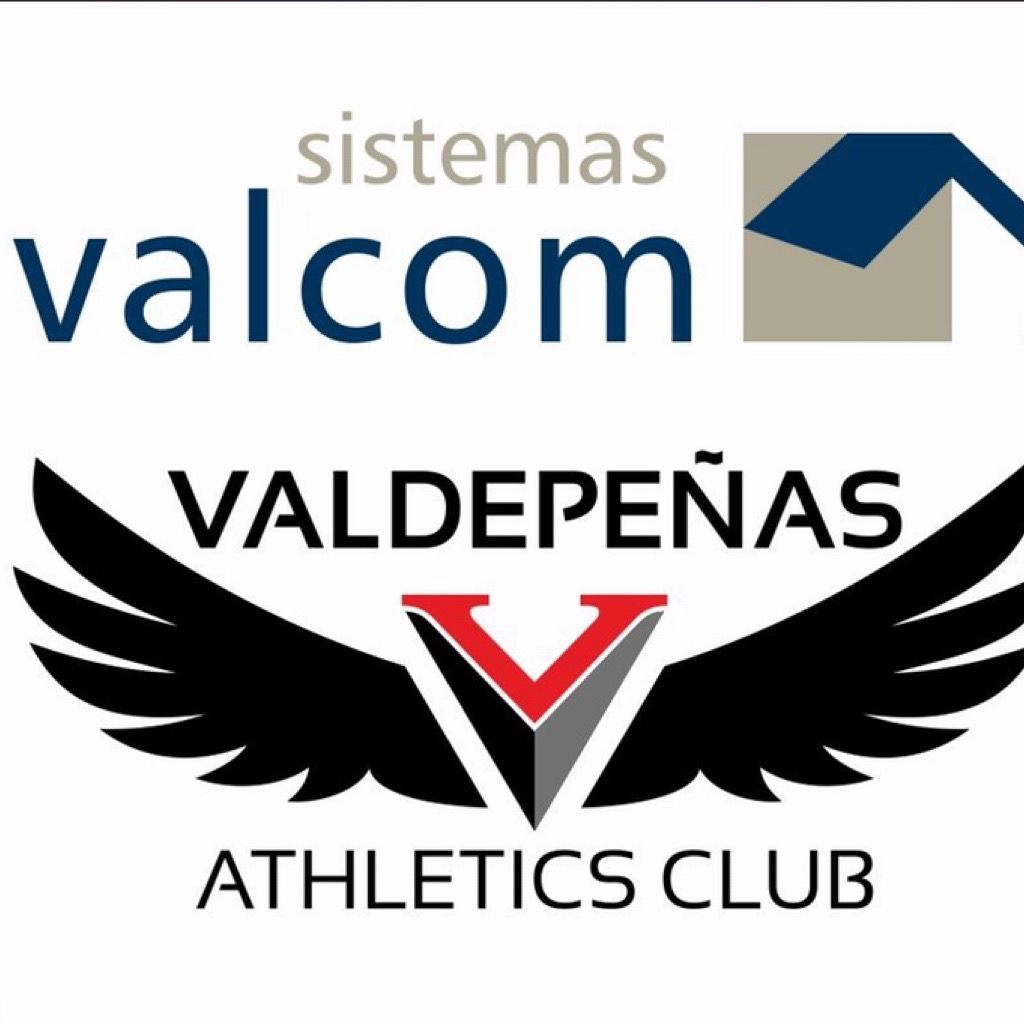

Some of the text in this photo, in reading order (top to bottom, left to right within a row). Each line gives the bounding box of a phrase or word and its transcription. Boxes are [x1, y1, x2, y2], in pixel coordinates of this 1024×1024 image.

[297, 110, 668, 186] sistemas
[13, 188, 692, 345] valcom
[168, 450, 904, 550] VALDEPEÑAS
[196, 849, 874, 910] ATHLETICS CLUB
